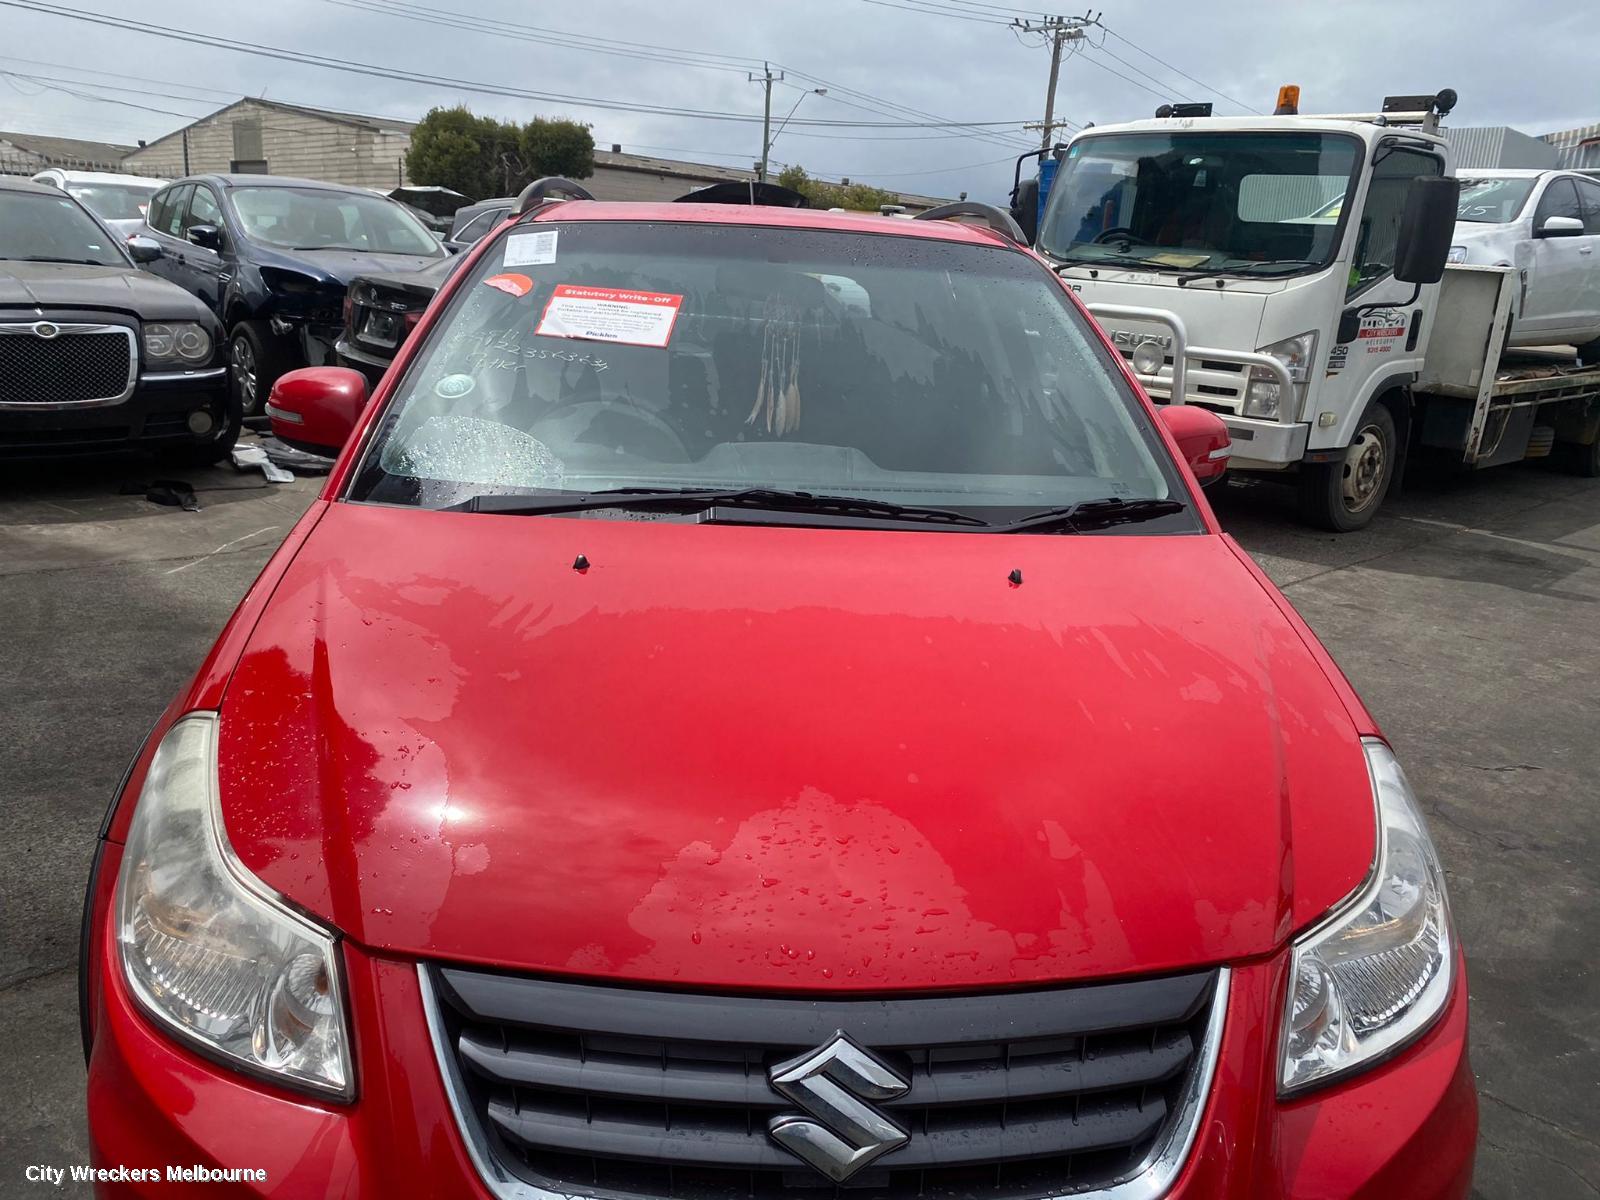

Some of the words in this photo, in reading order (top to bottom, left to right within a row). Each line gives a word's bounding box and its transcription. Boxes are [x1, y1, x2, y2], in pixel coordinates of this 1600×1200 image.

[564, 288, 617, 299] Statutory
[618, 292, 672, 303] Write-Off
[1111, 329, 1172, 350] ISUZU
[1331, 346, 1348, 355] 450
